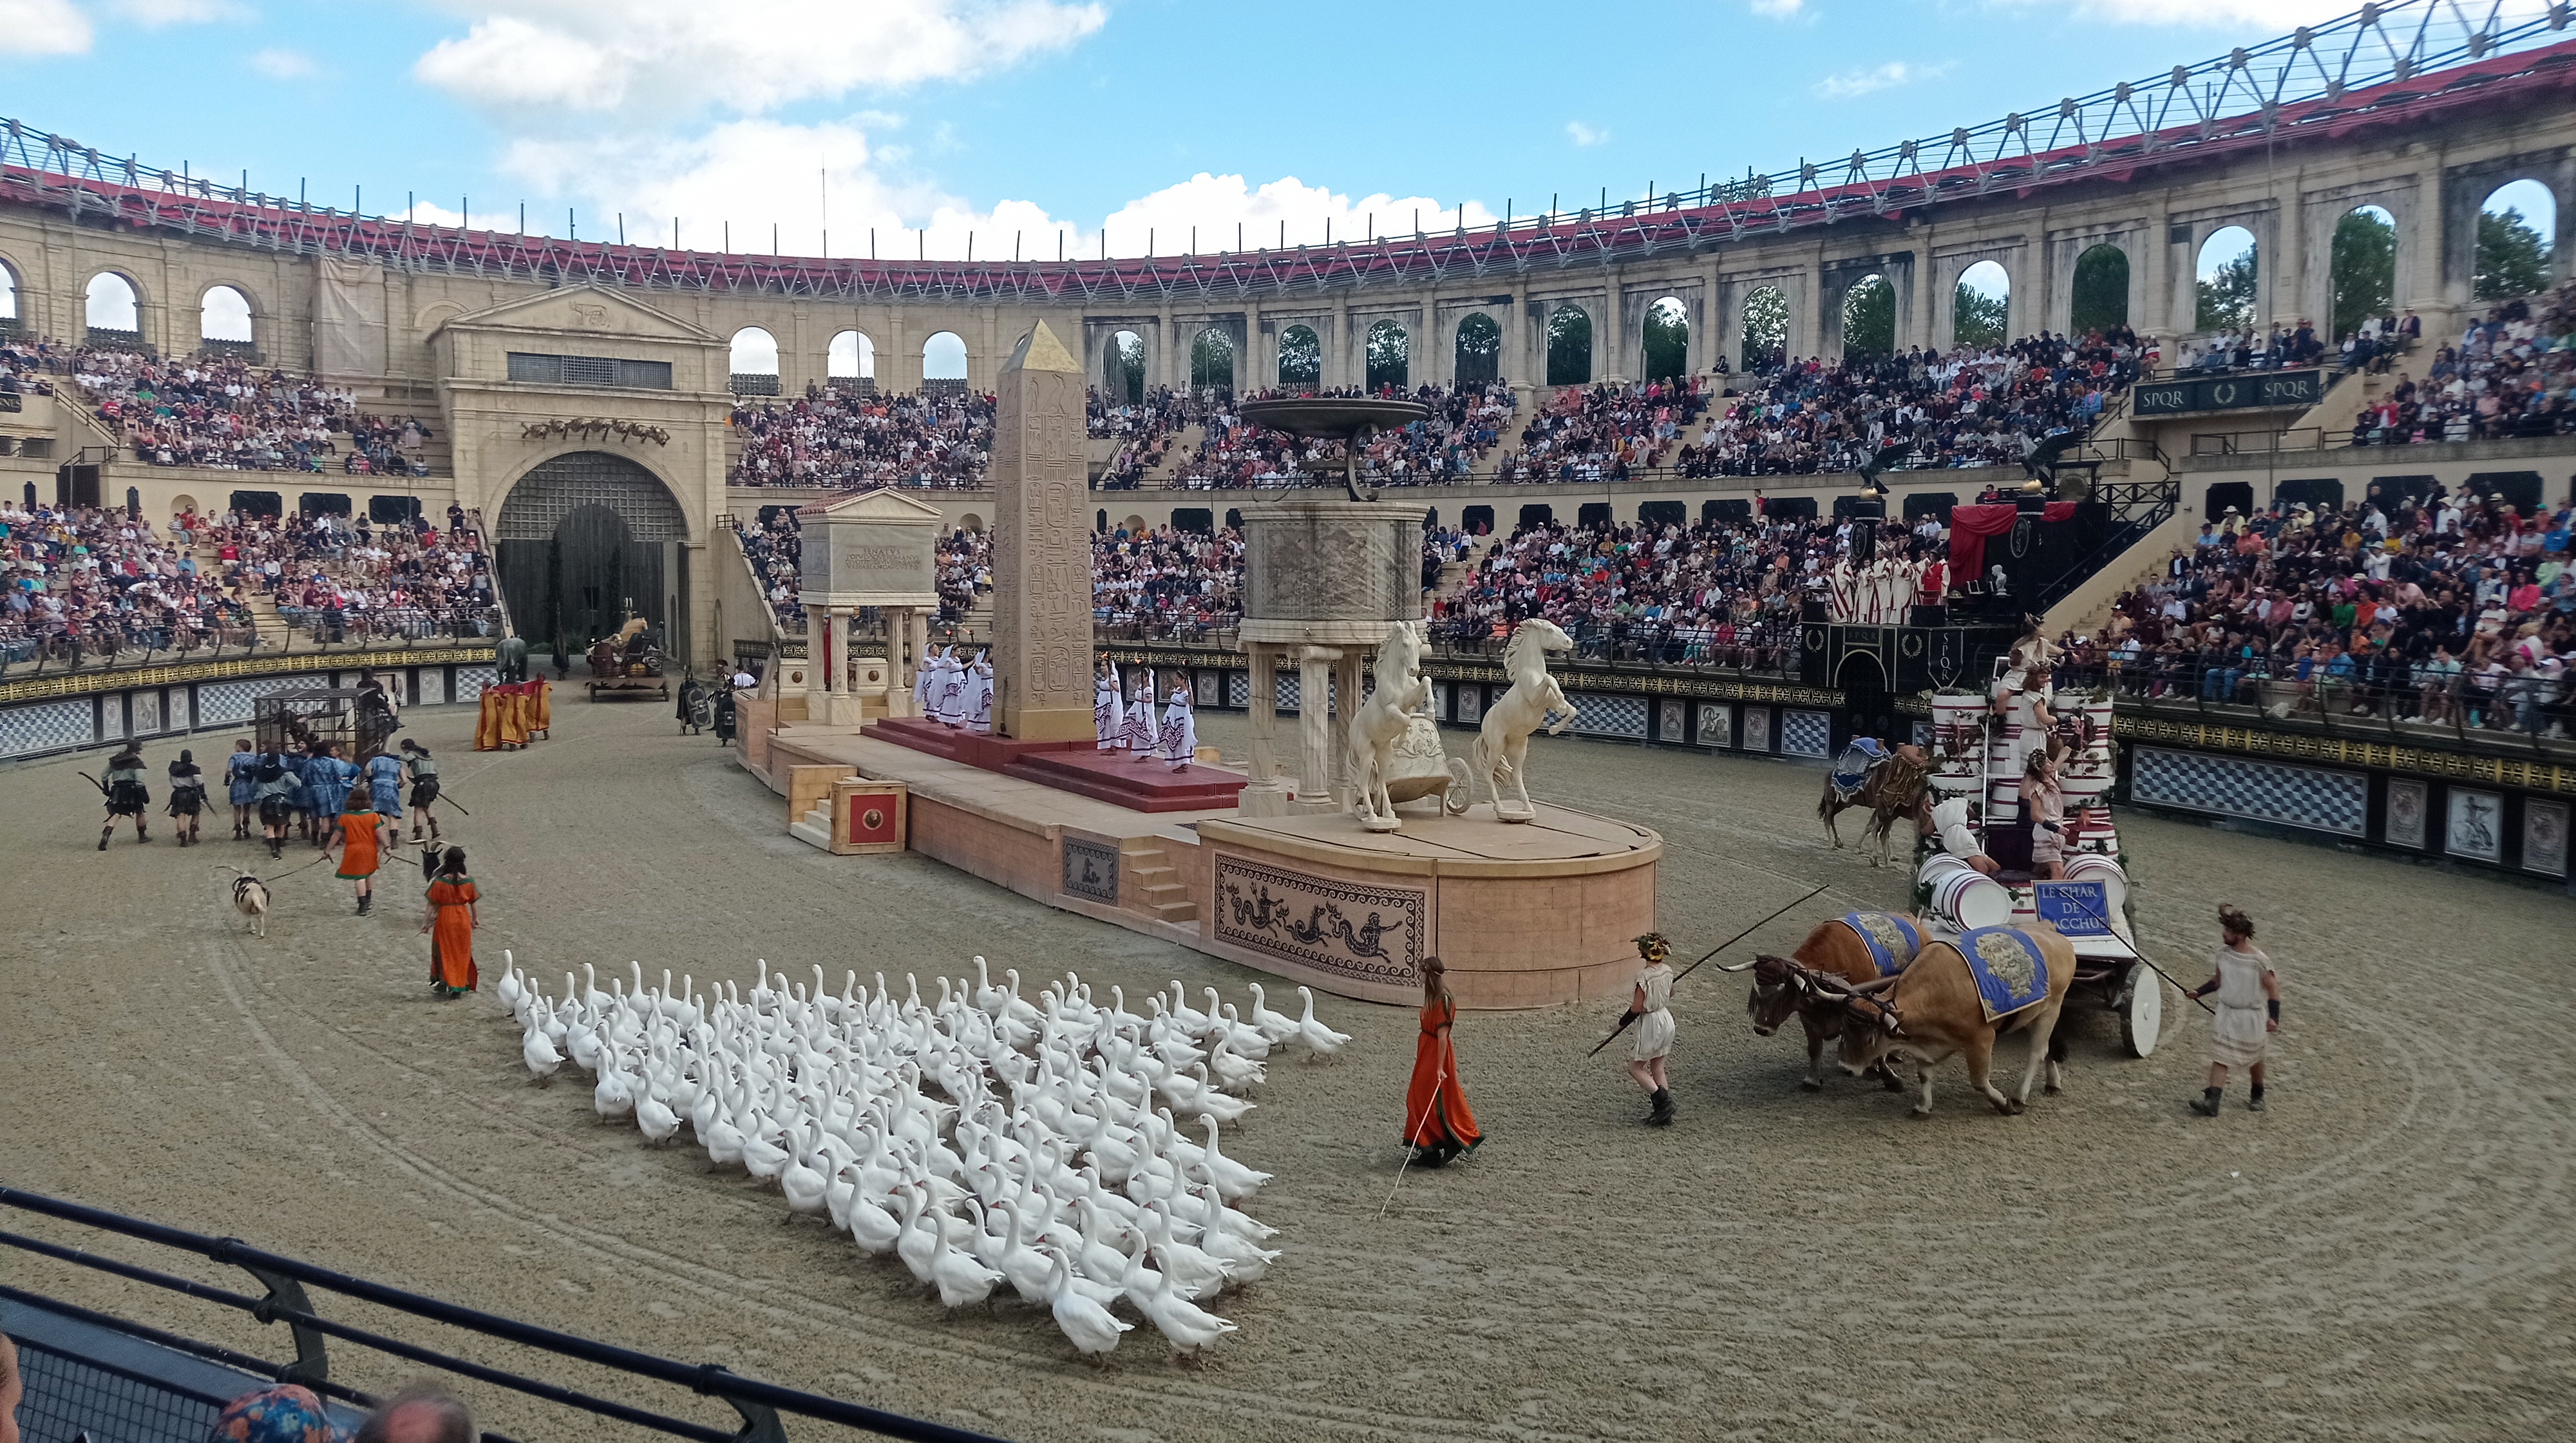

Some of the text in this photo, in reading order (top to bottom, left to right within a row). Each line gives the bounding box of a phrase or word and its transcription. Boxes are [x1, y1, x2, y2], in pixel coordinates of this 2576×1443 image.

[2143, 381, 2309, 408] SPQR SPQR
[1848, 631, 1877, 641] SPQR
[1940, 633, 1953, 680] SPQR
[2041, 886, 2098, 898] LE CHAR
[2061, 903, 2080, 913] DE
[2053, 917, 2107, 930] ACCHUS
